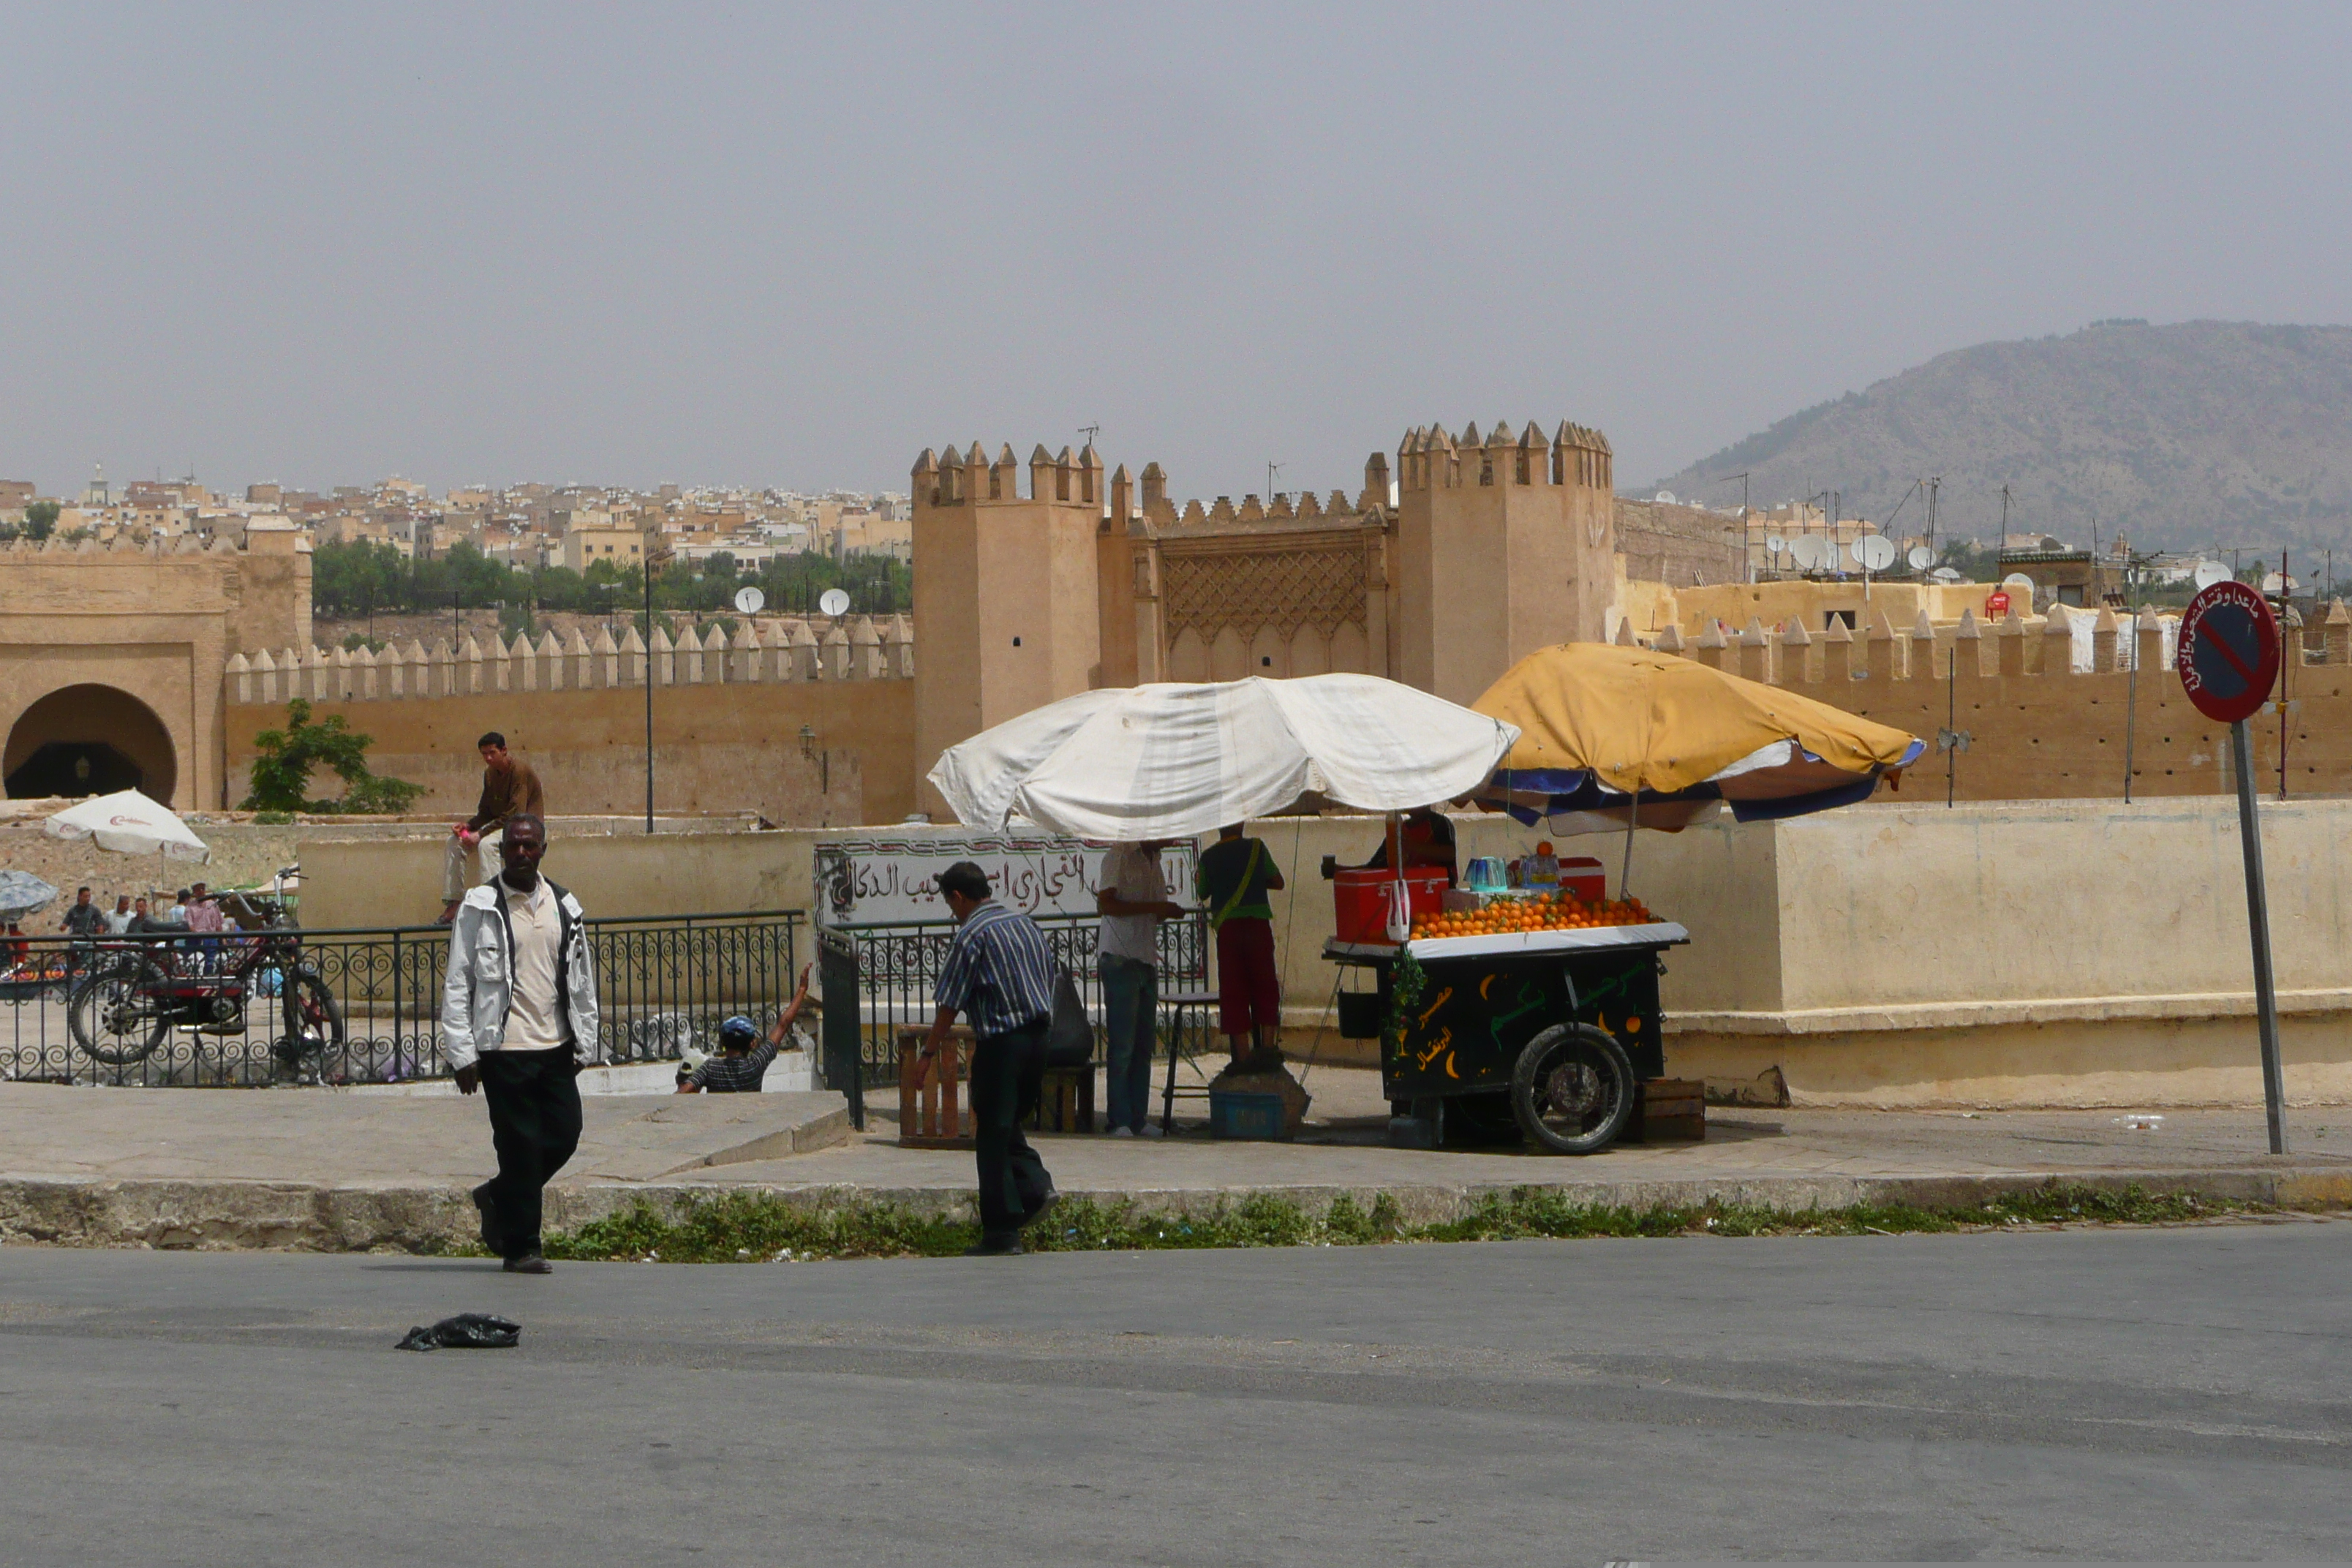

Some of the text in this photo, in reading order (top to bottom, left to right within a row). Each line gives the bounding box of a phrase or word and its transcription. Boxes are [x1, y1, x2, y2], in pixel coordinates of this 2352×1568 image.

[2207, 587, 2230, 608] وقت
[832, 859, 899, 917] الدكالي
[1012, 853, 1085, 915] التجاري
